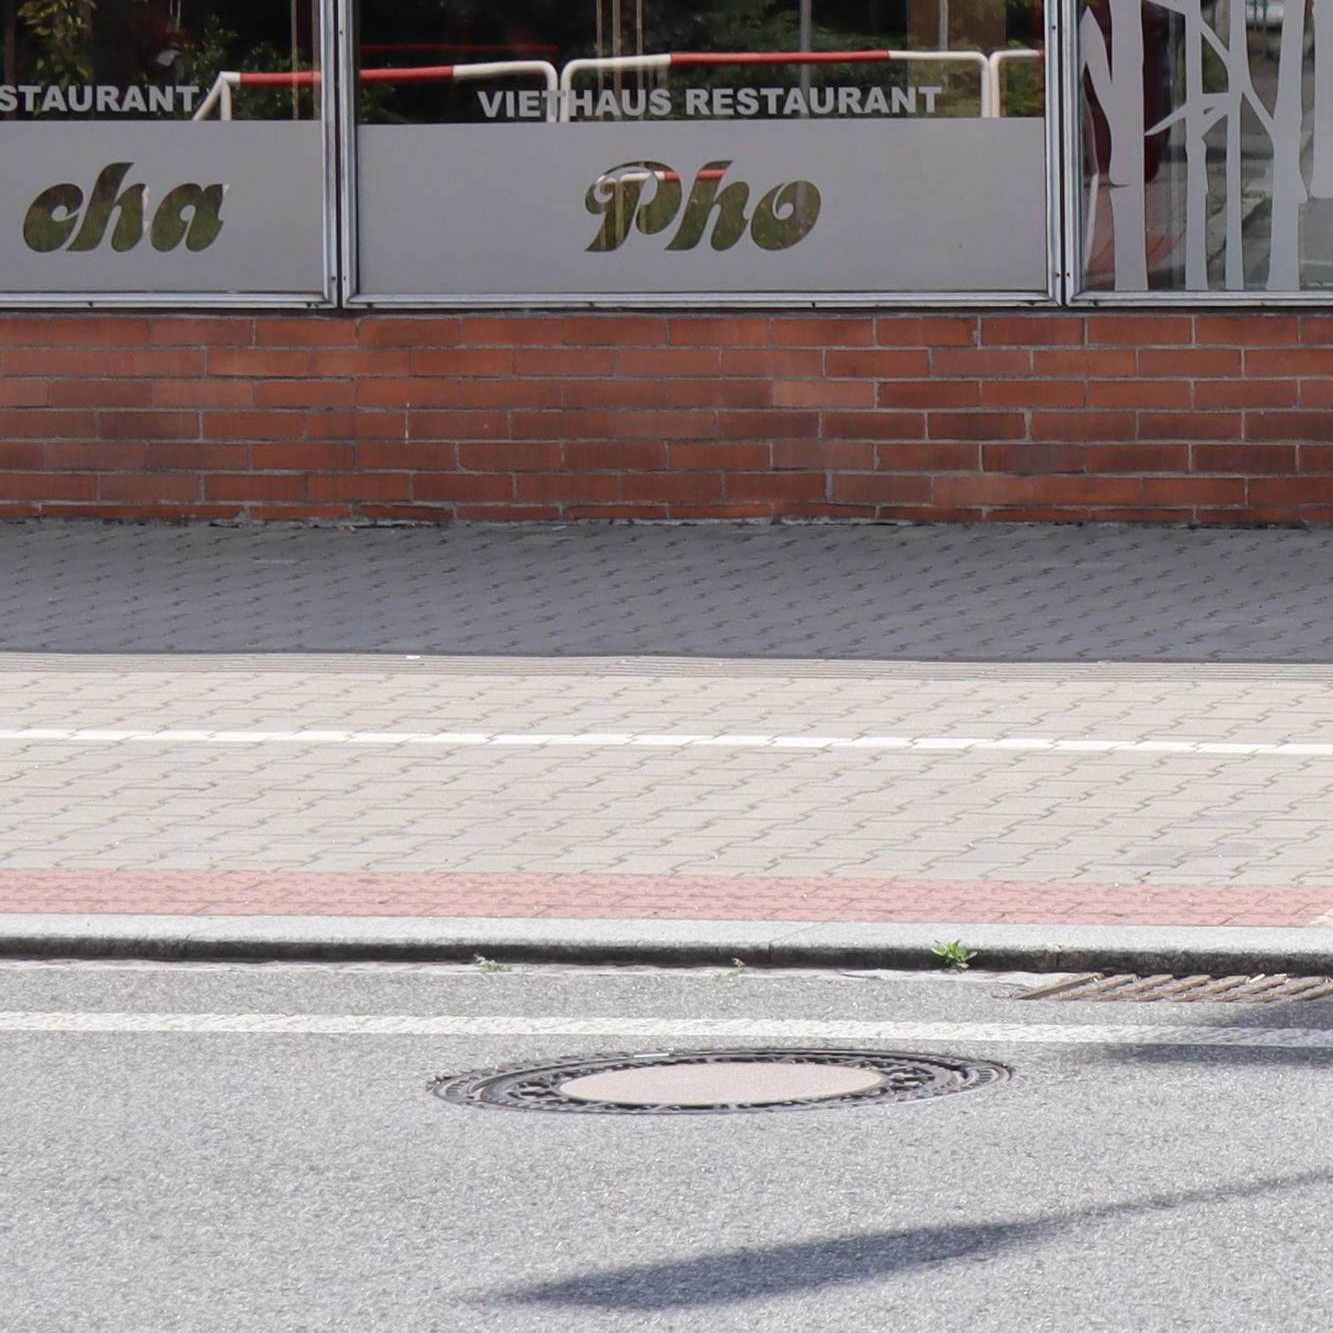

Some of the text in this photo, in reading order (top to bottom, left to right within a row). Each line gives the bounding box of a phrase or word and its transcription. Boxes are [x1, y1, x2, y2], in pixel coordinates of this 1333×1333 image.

[477, 86, 942, 118] VIETHAUS RESTAURANT
[23, 162, 230, 253] cha
[584, 160, 822, 252] Pho
